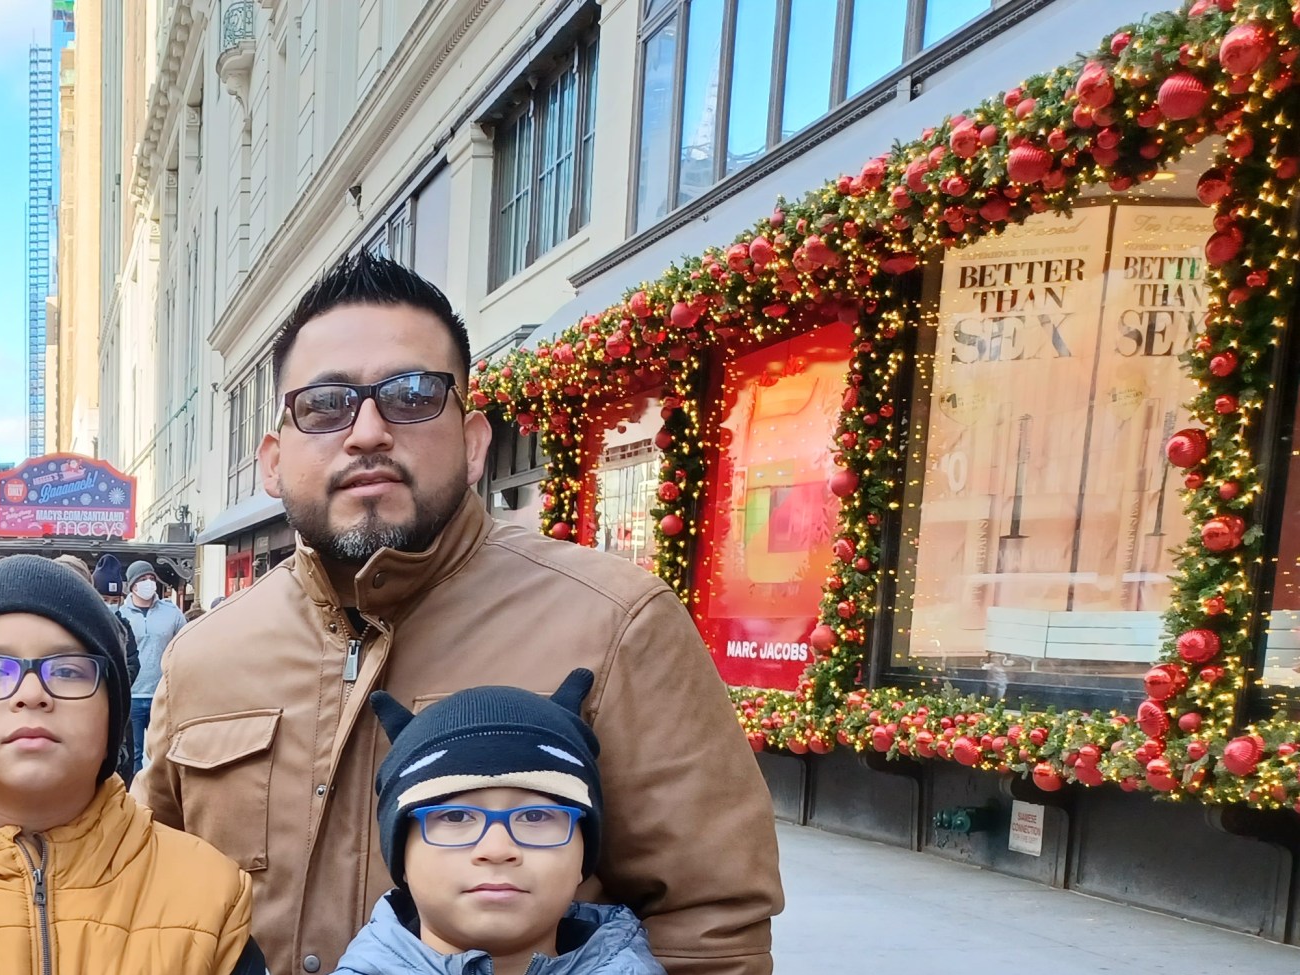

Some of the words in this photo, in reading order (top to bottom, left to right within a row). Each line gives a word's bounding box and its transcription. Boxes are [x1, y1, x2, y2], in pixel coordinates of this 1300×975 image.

[960, 250, 1018, 261] EXPERIENCE
[1023, 249, 1038, 257] THE
[1042, 247, 1072, 256] POWER
[958, 257, 1086, 290] BETTER
[1122, 256, 1203, 281] BETTE
[972, 286, 1067, 314] THAN
[1133, 283, 1206, 307] THAN
[950, 312, 1076, 364] SEX
[36, 510, 125, 522] MACYS.COM/SANTALAND
[727, 640, 757, 659] MARC
[760, 642, 808, 661] JACOBS
